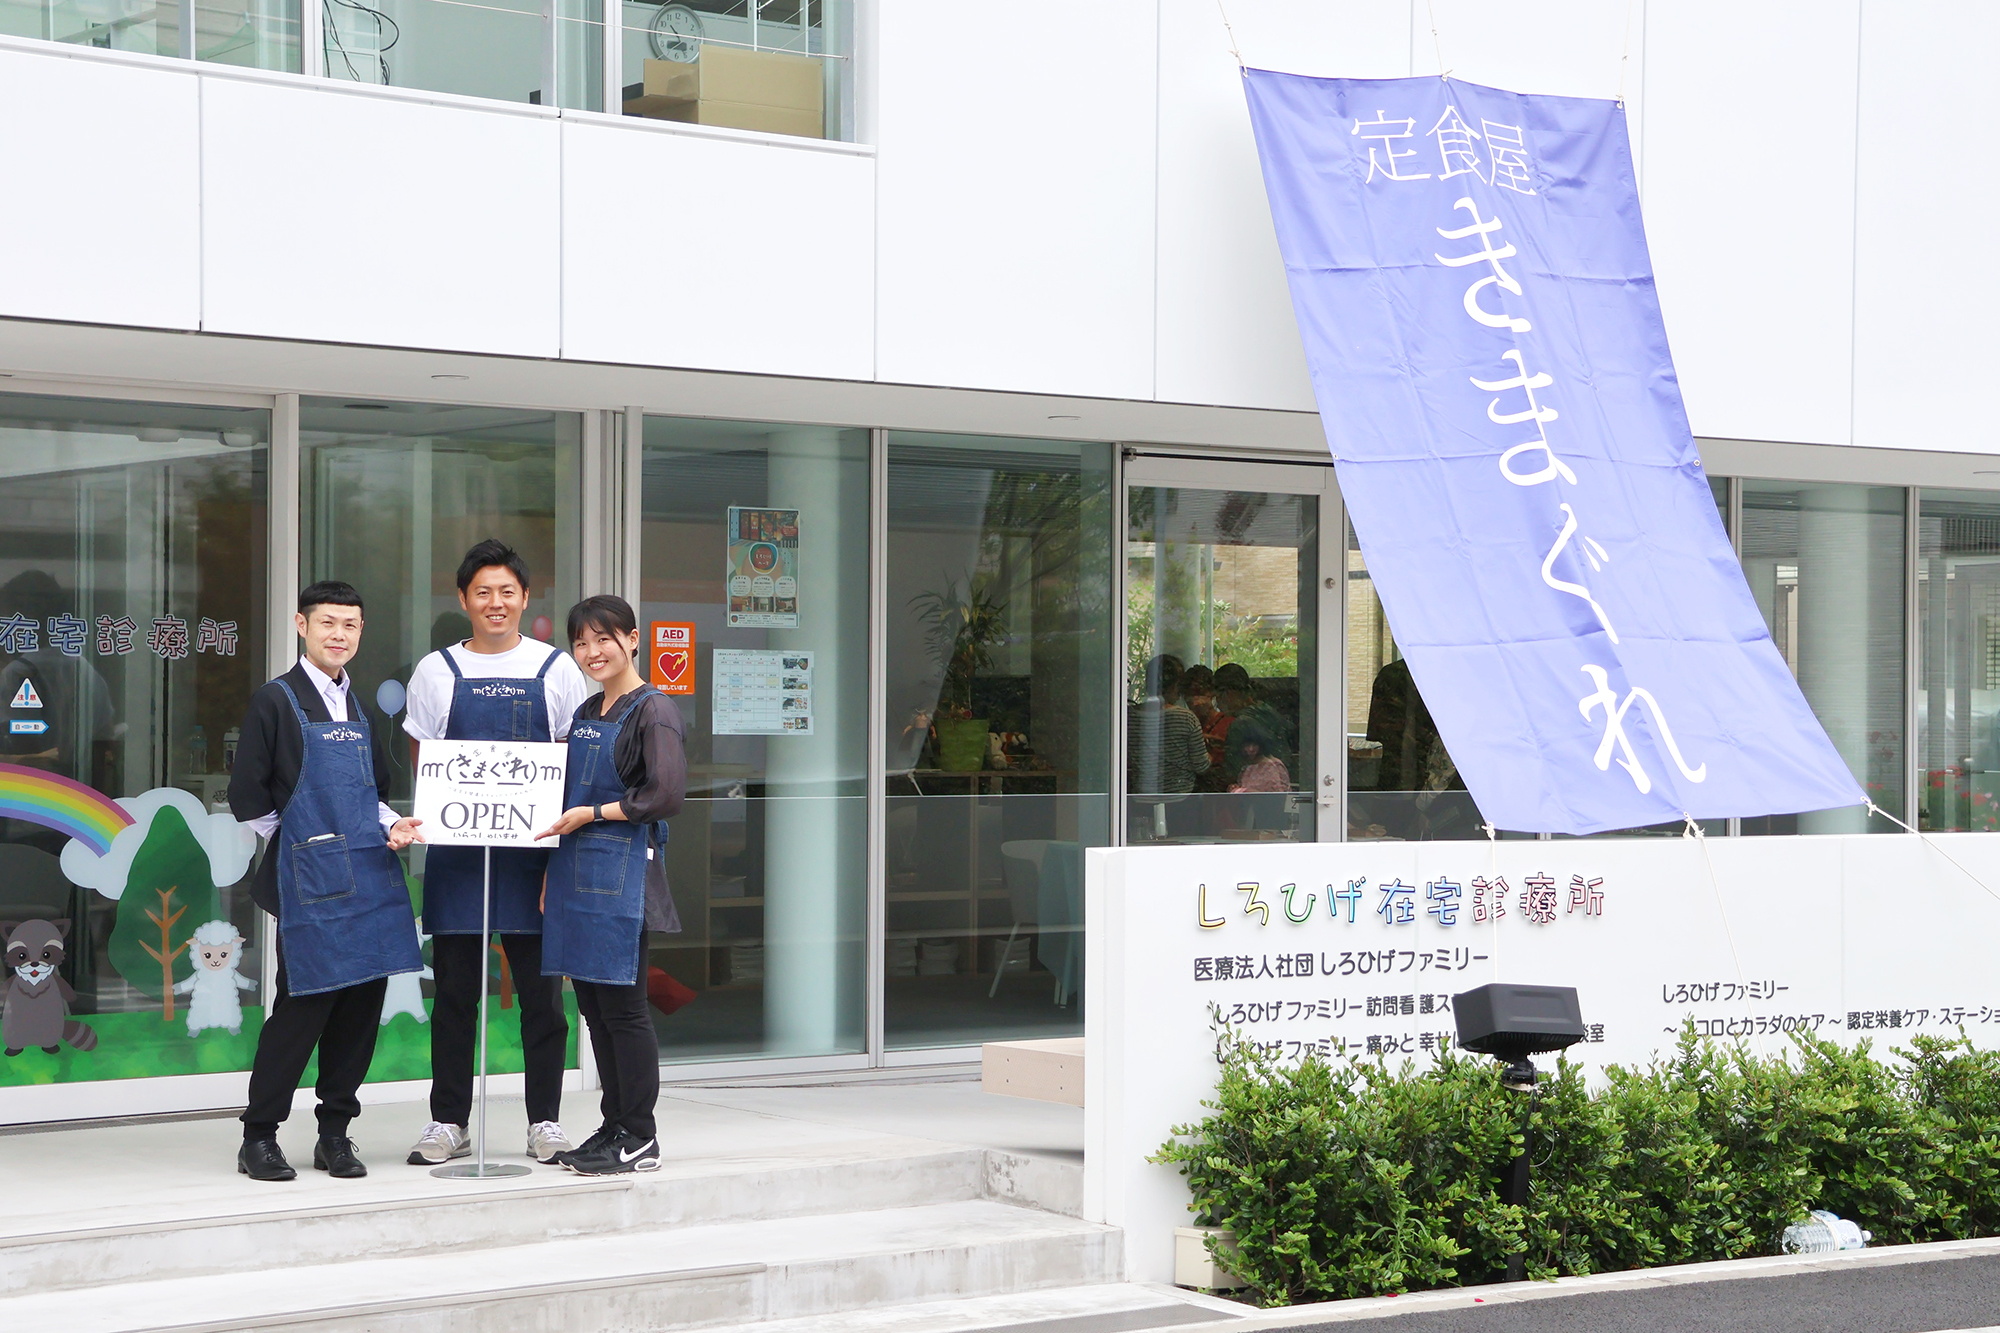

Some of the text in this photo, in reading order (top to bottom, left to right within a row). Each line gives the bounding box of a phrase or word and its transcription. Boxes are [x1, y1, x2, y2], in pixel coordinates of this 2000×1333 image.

[1351, 105, 1538, 196] 定食屋
[1434, 197, 1707, 795] きまぐれ
[0, 612, 238, 659] 在宅診療所
[662, 629, 685, 640] AED
[440, 801, 537, 831] OPEN
[1198, 871, 1605, 929] しろひげ在宅診療所
[1194, 947, 1489, 981] 医療法人社団 しろひげファミリー
[1663, 980, 1789, 1003] しろひげファミリー
